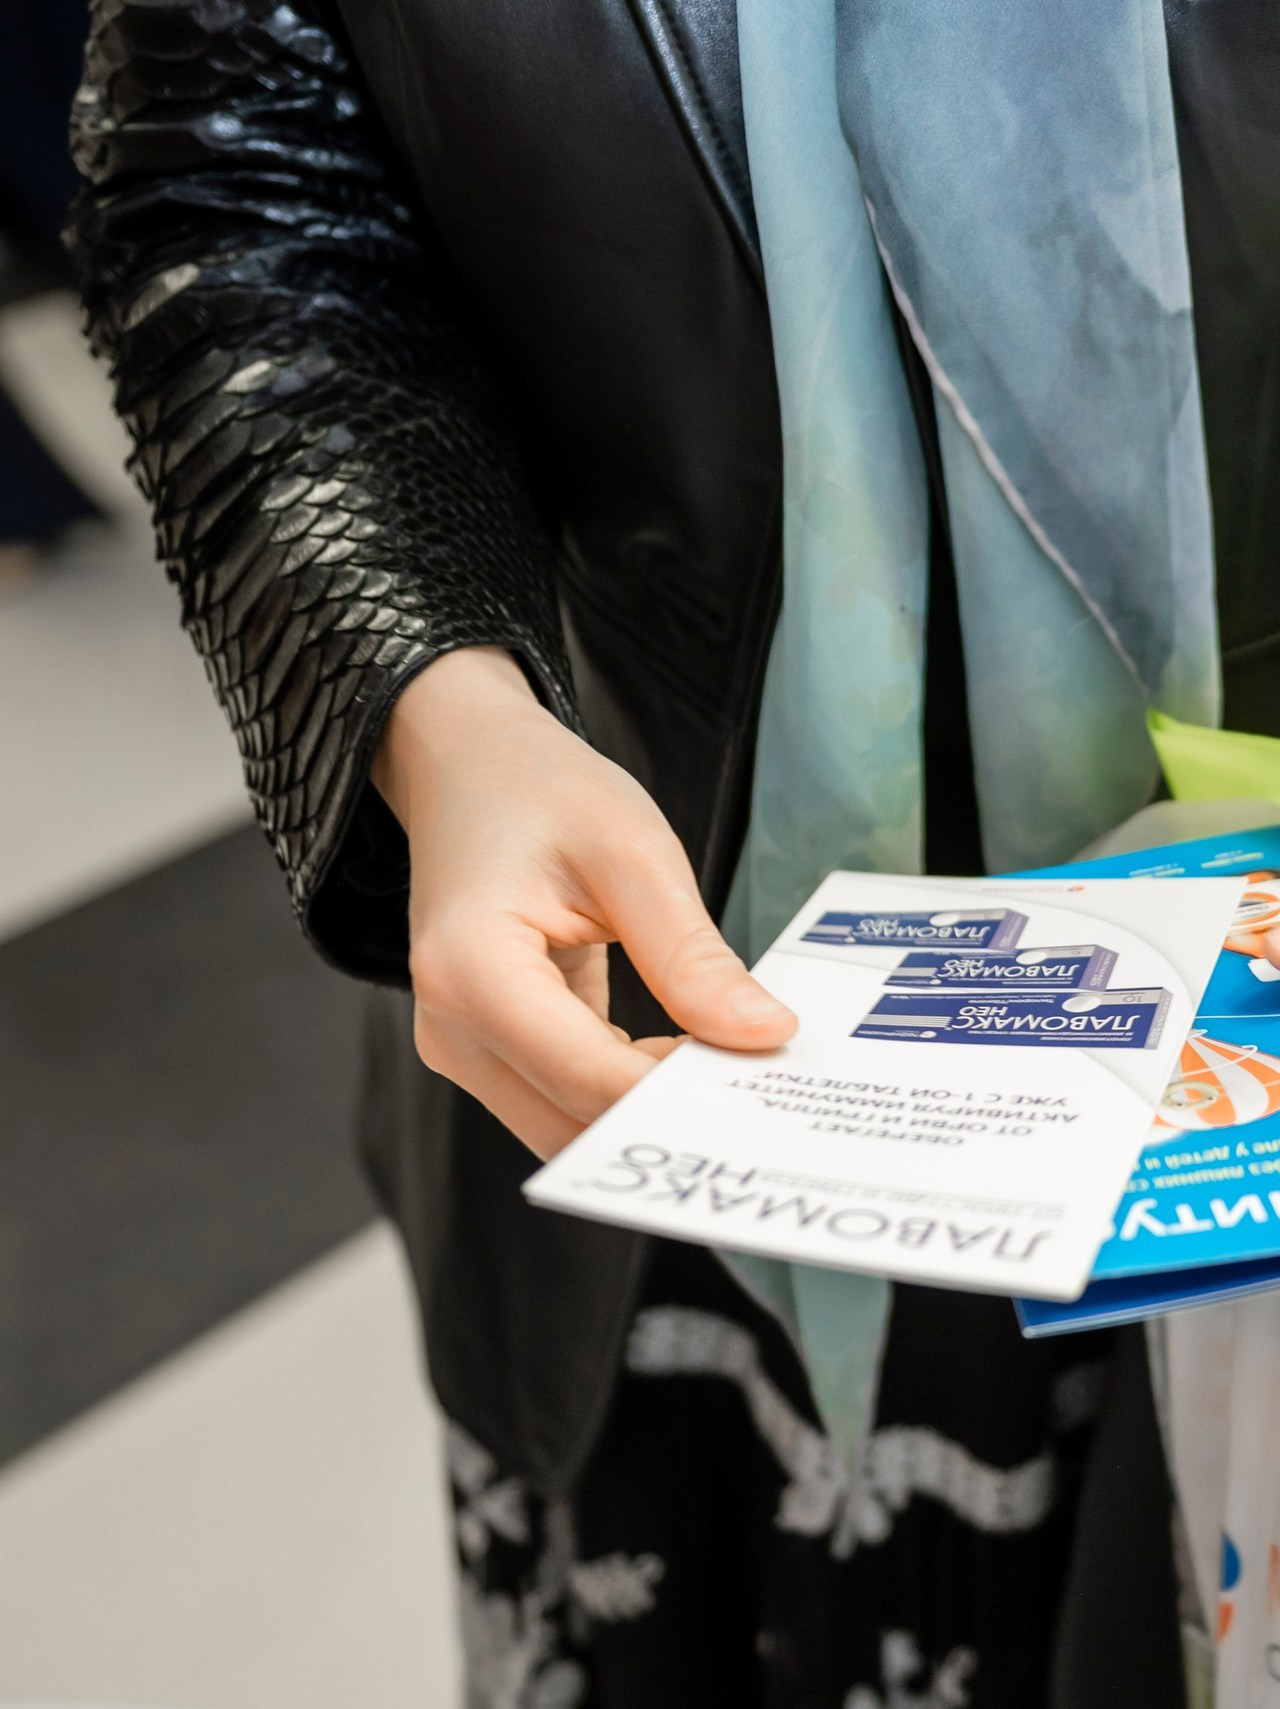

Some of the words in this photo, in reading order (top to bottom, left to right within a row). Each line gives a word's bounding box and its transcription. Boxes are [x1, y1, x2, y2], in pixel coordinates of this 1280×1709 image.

[852, 925, 990, 938] ЛАВОМАКС
[937, 964, 1080, 977] ЛАВОМАКС
[944, 959, 985, 968] НЕО
[1123, 995, 1143, 1003] 10
[959, 1006, 1008, 1016] НЕО
[951, 1014, 1140, 1030] ЛАВОМАКС
[725, 1079, 905, 1110] ИММУНИТЕТ
[983, 1093, 1002, 1104] С
[1011, 1094, 1067, 1108] УЖЕ
[881, 1115, 902, 1125] И
[911, 1103, 1079, 1124] АКТИВИРУЯ
[909, 1117, 987, 1131] ОРВИ
[807, 1122, 963, 1147] ОБЕРЕГАЕТ
[997, 1125, 1032, 1138] ОТ
[1235, 1141, 1249, 1158] у
[1144, 1157, 1161, 1171] и
[1164, 1145, 1230, 1170] детей
[622, 1144, 756, 1186] НЕО
[591, 1162, 1053, 1263] ЛАВОМАКС
